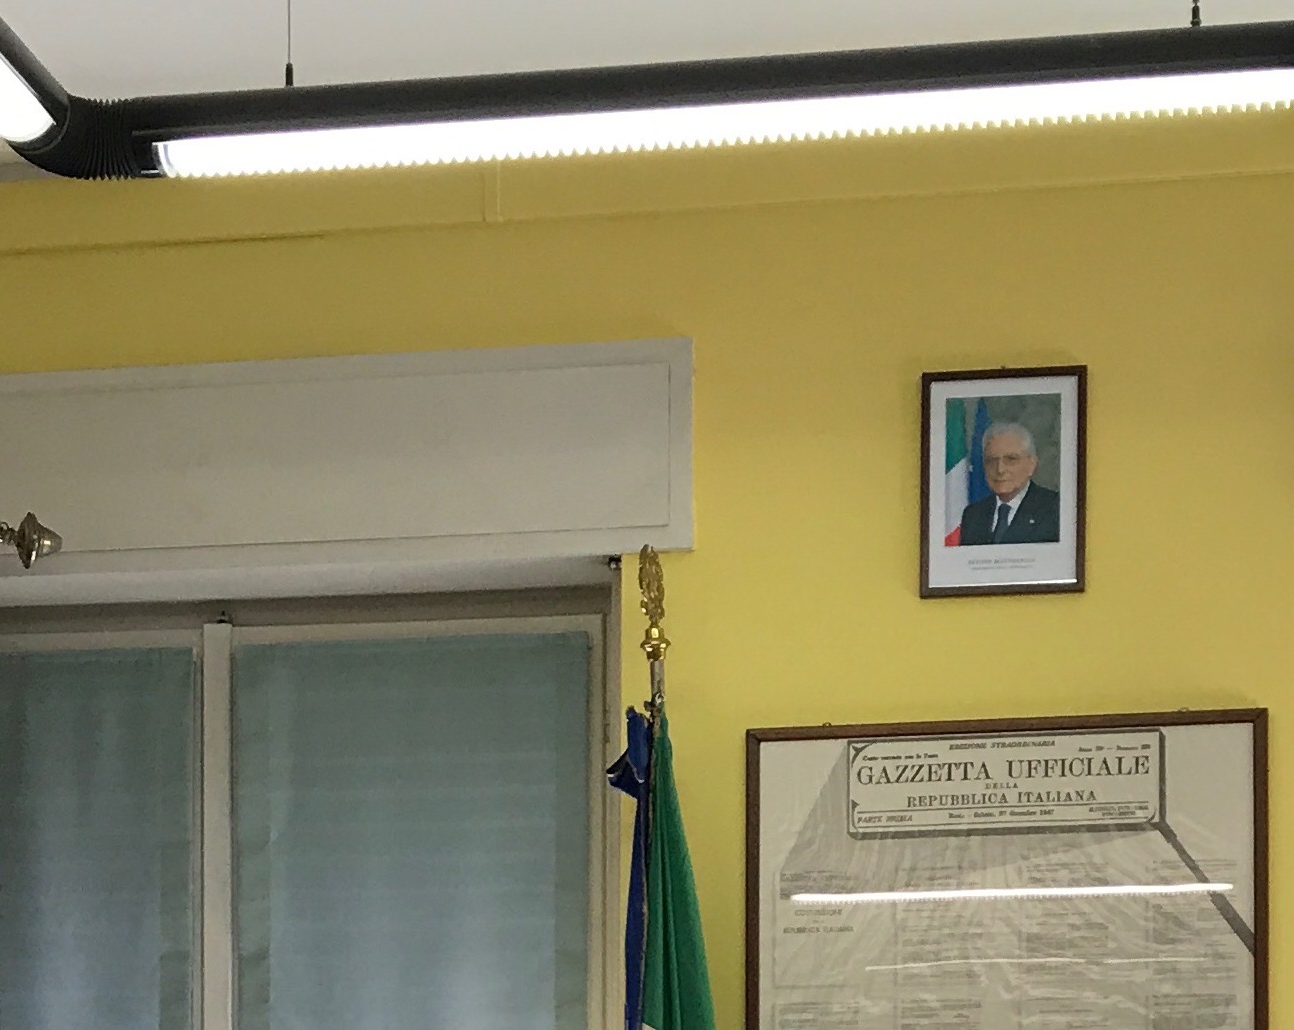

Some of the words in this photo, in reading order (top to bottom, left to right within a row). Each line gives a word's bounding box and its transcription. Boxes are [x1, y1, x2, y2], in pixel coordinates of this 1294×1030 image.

[857, 761, 993, 785] GAZZETTA
[1006, 755, 1150, 779] UFFICIALE
[985, 782, 1019, 790] DELLA
[907, 793, 1009, 808] REPUBBLICA
[1017, 790, 1097, 803] ITALIANA
